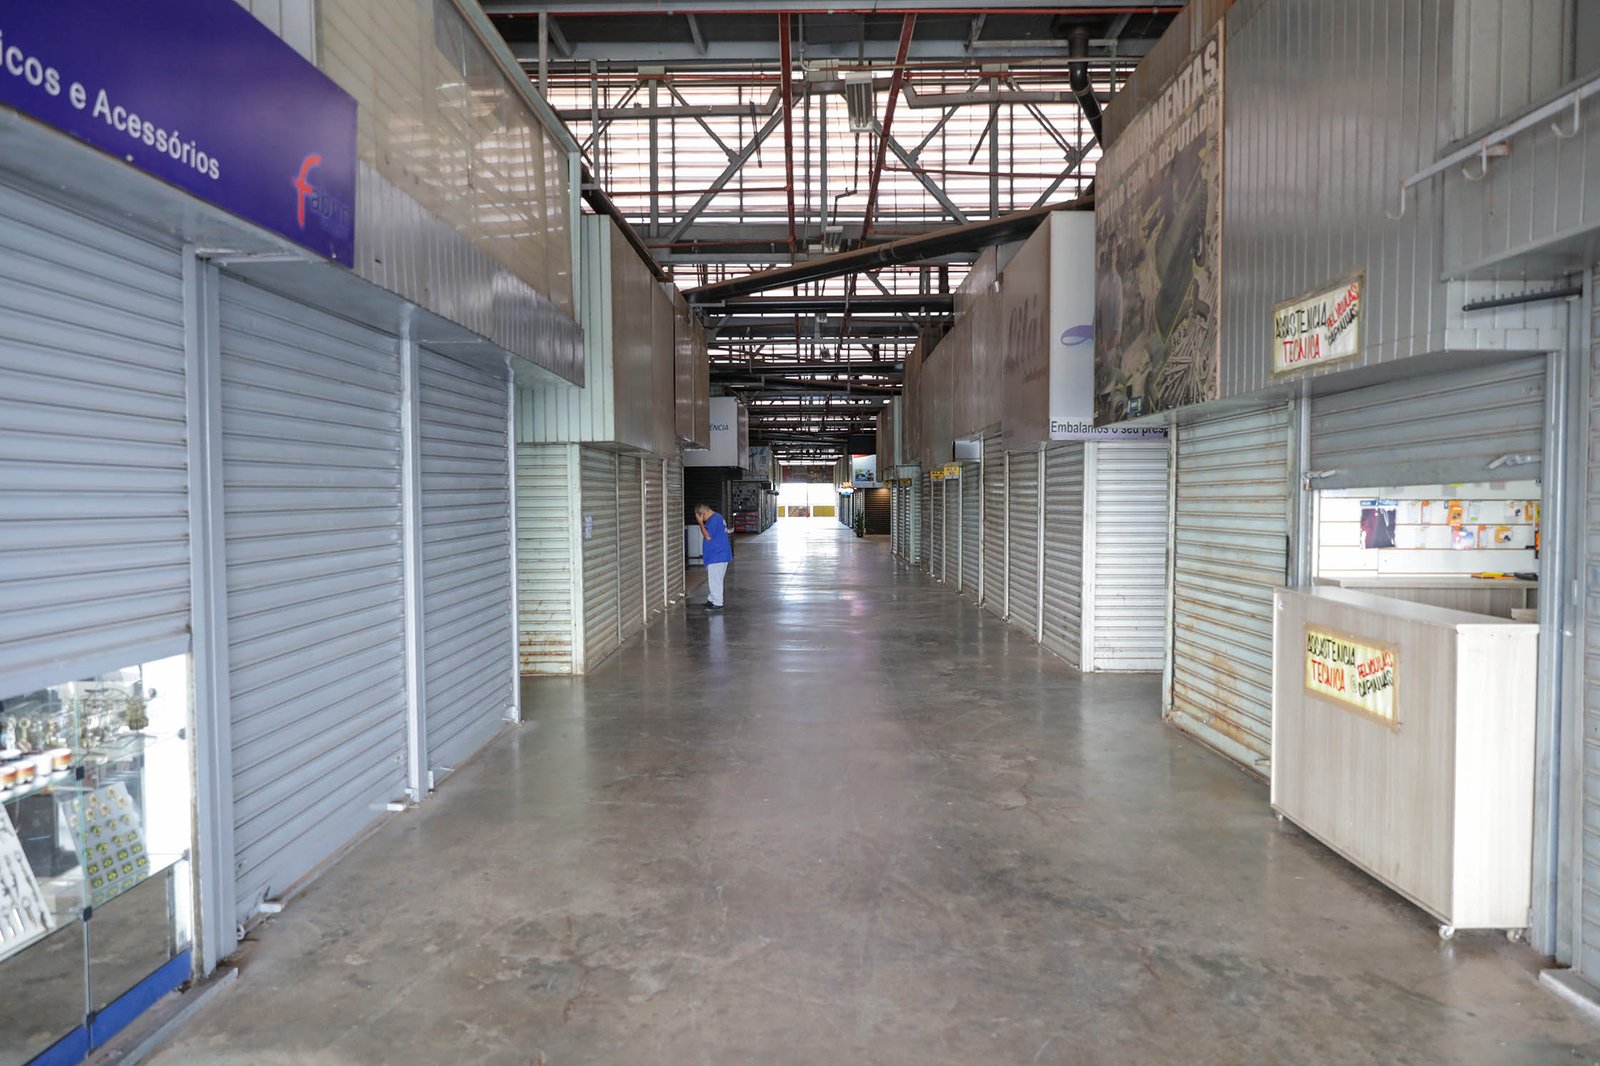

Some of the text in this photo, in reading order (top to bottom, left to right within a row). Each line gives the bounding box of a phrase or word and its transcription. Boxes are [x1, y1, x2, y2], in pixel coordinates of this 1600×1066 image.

[69, 82, 86, 109] e
[93, 88, 220, 180] Acessórios
[1158, 94, 1217, 171] DEPUTADO
[1283, 333, 1321, 363] TECNICA
[1312, 660, 1345, 691] TECNICA
